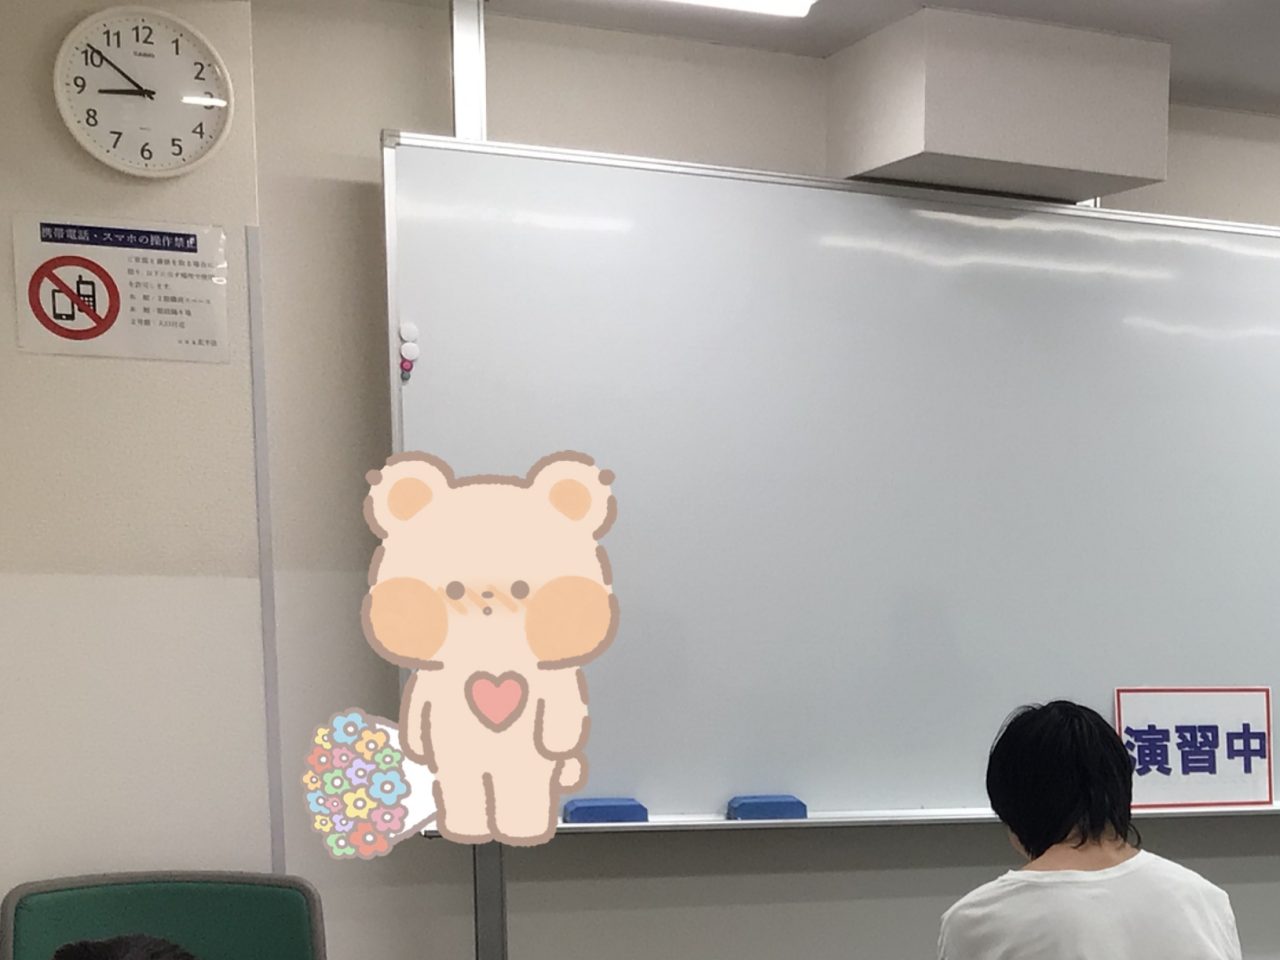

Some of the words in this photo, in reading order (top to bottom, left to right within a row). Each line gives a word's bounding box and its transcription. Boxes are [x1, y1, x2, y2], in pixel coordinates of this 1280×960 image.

[103, 30, 122, 48] 11
[132, 26, 154, 45] 12
[171, 38, 180, 56] 1
[81, 49, 103, 68] 10
[193, 62, 205, 81] 2
[73, 76, 86, 94] 9
[85, 108, 98, 127] 8
[192, 122, 205, 139] 4
[109, 131, 123, 149] 7
[171, 138, 183, 156] 5
[140, 142, 153, 161] 6
[1124, 723, 1266, 777] 演習中
